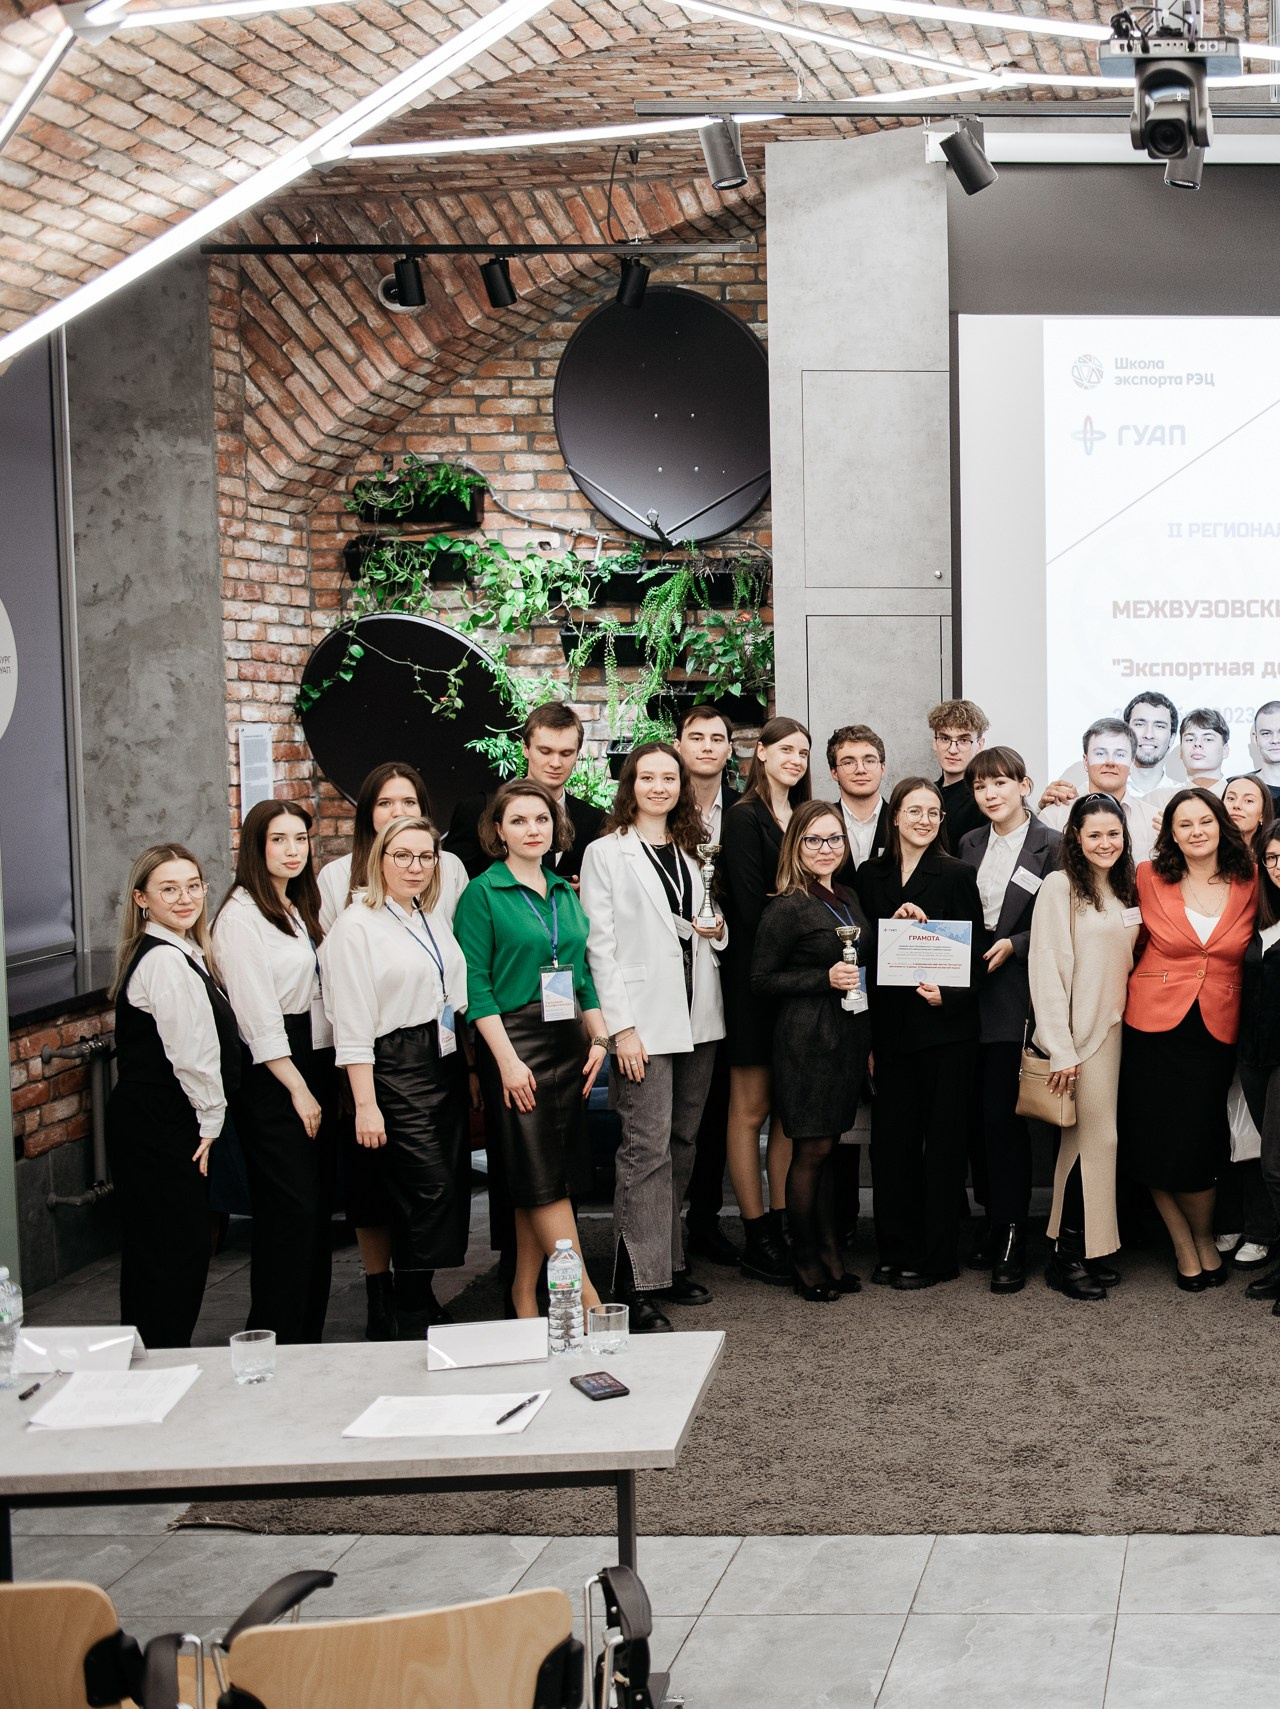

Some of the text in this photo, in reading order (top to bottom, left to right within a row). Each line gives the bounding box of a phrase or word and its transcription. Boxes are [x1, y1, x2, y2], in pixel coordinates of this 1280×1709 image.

[1114, 357, 1165, 370] Школа
[1114, 373, 1216, 388] экспорта РЭЦ
[1117, 424, 1187, 447] ГУАП
[1111, 657, 1255, 680] "Экспортная
[1217, 707, 1255, 724] 023
